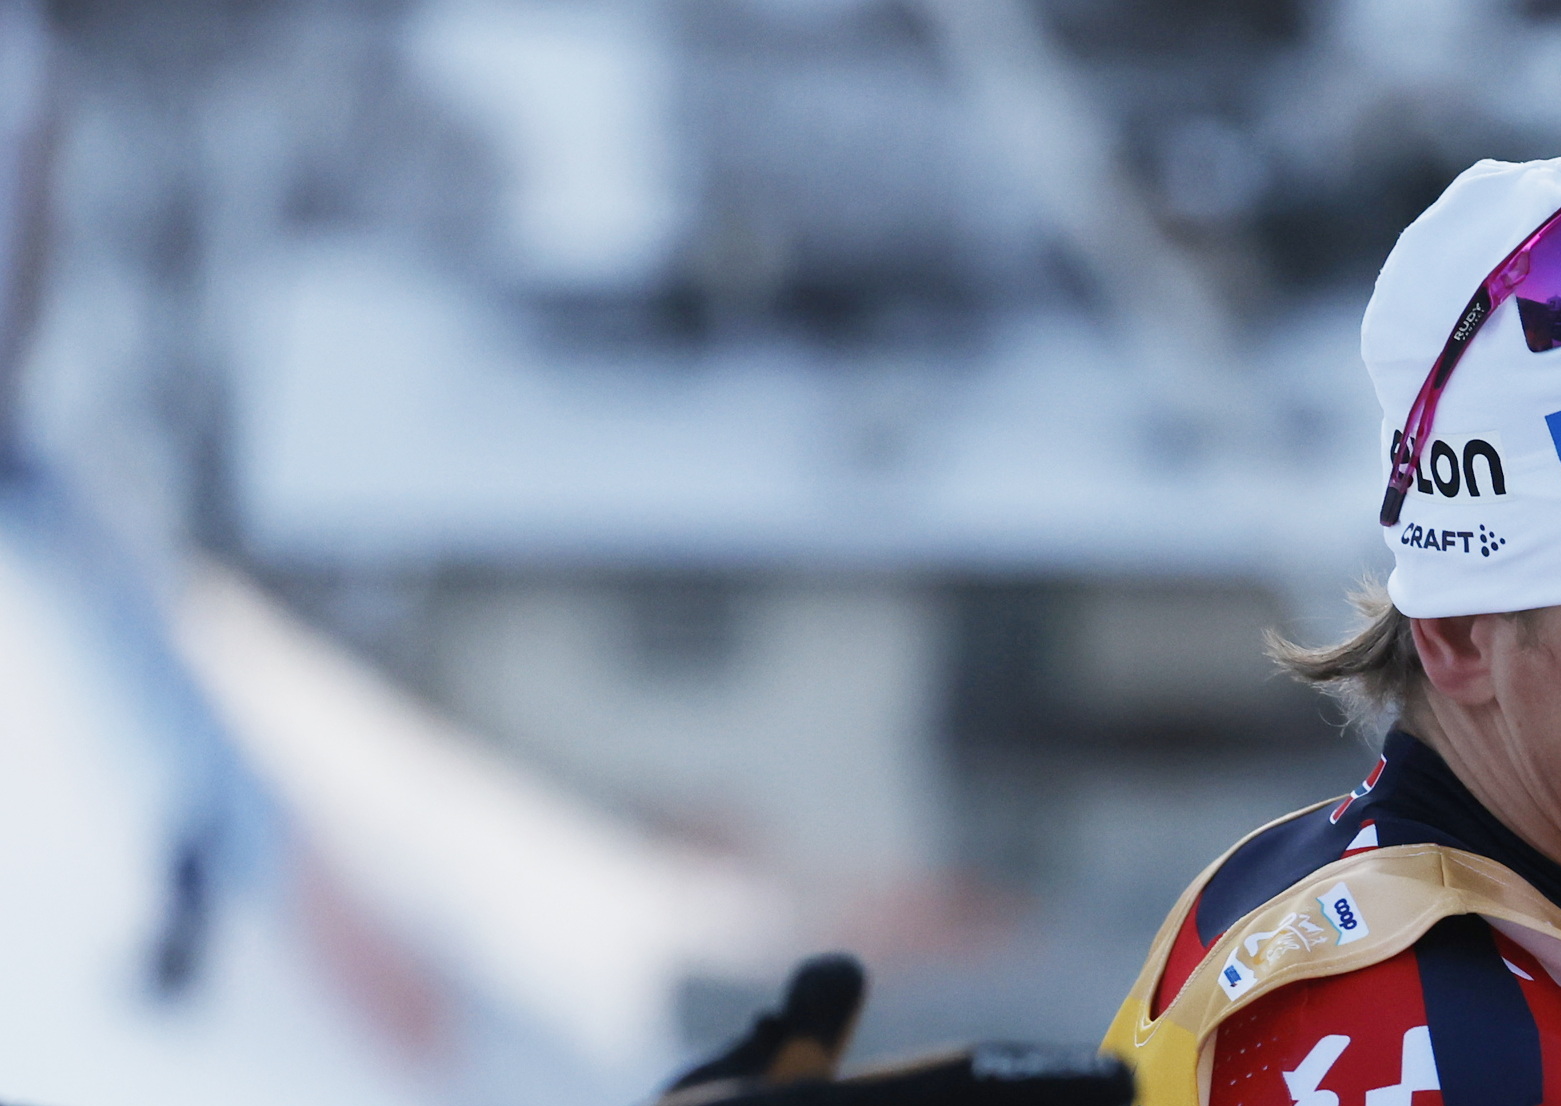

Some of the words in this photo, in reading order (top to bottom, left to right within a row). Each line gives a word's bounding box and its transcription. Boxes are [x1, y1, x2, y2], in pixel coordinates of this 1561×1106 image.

[1454, 302, 1482, 341] RUDY
[1401, 522, 1474, 553] CRAFT
[1334, 898, 1357, 931] coop
